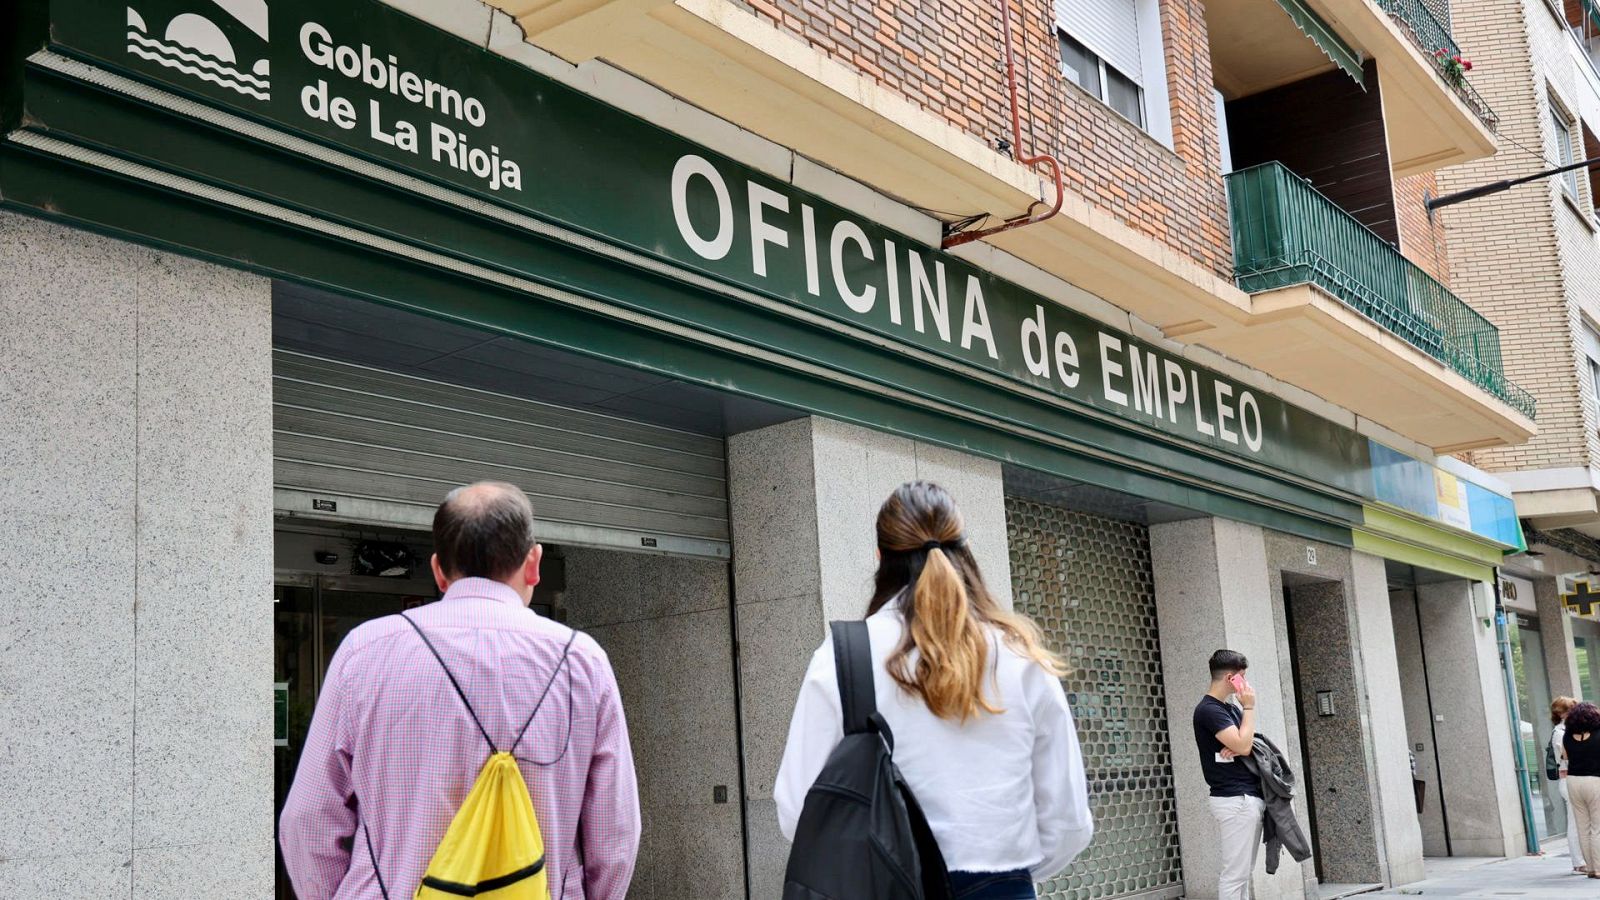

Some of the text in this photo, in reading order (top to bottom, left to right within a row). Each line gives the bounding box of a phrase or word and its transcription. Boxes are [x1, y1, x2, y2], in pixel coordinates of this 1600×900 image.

[299, 21, 486, 128] Gobierno
[301, 79, 522, 191] de La Rioja
[671, 154, 1263, 453] OFICINA de EMPLEO
